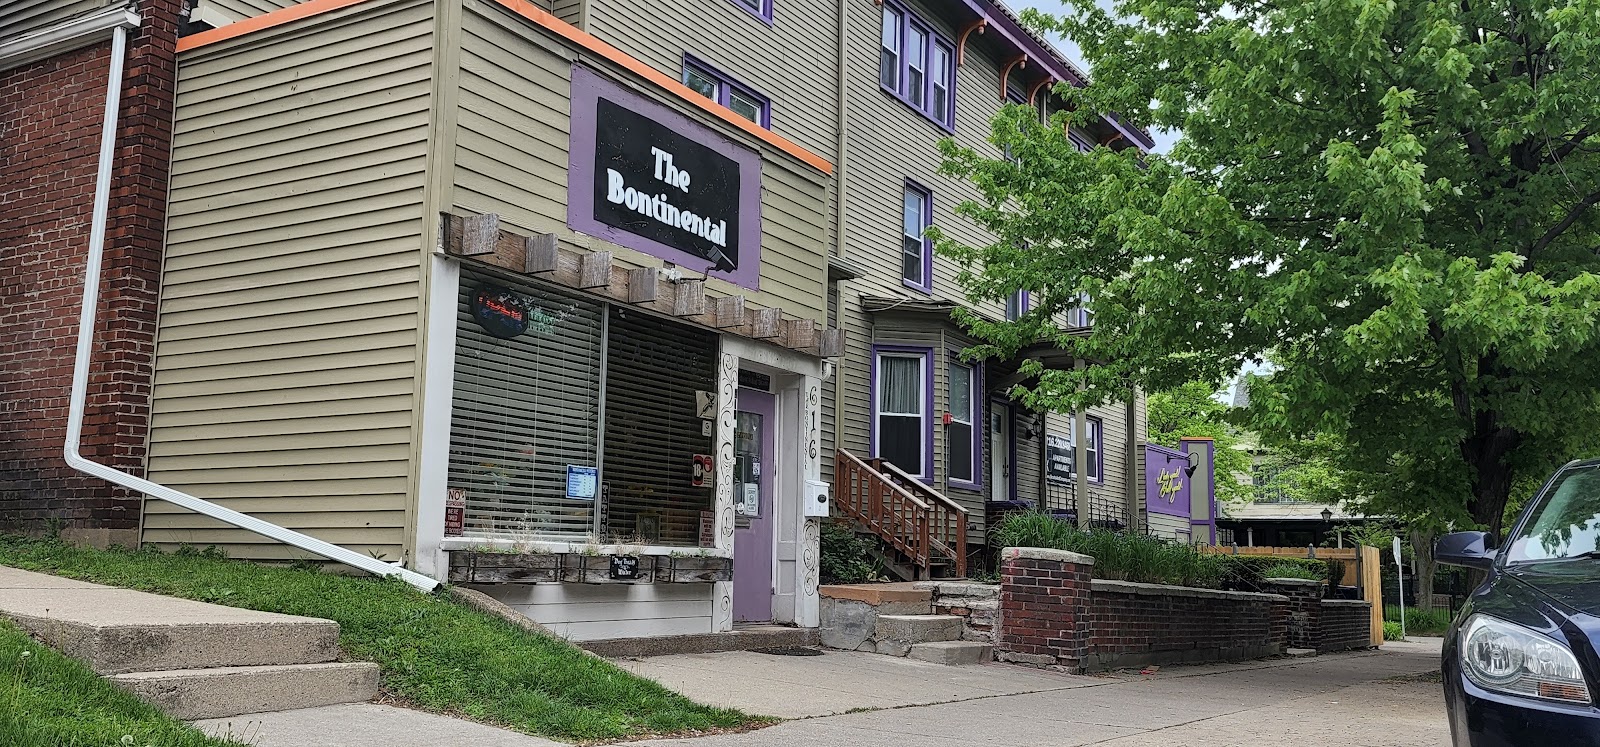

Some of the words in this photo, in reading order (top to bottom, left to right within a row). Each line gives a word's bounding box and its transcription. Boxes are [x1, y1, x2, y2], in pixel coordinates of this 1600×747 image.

[651, 146, 690, 193] The
[607, 168, 726, 247] Bontinental
[809, 386, 817, 459] 616
[448, 490, 461, 501] NO
